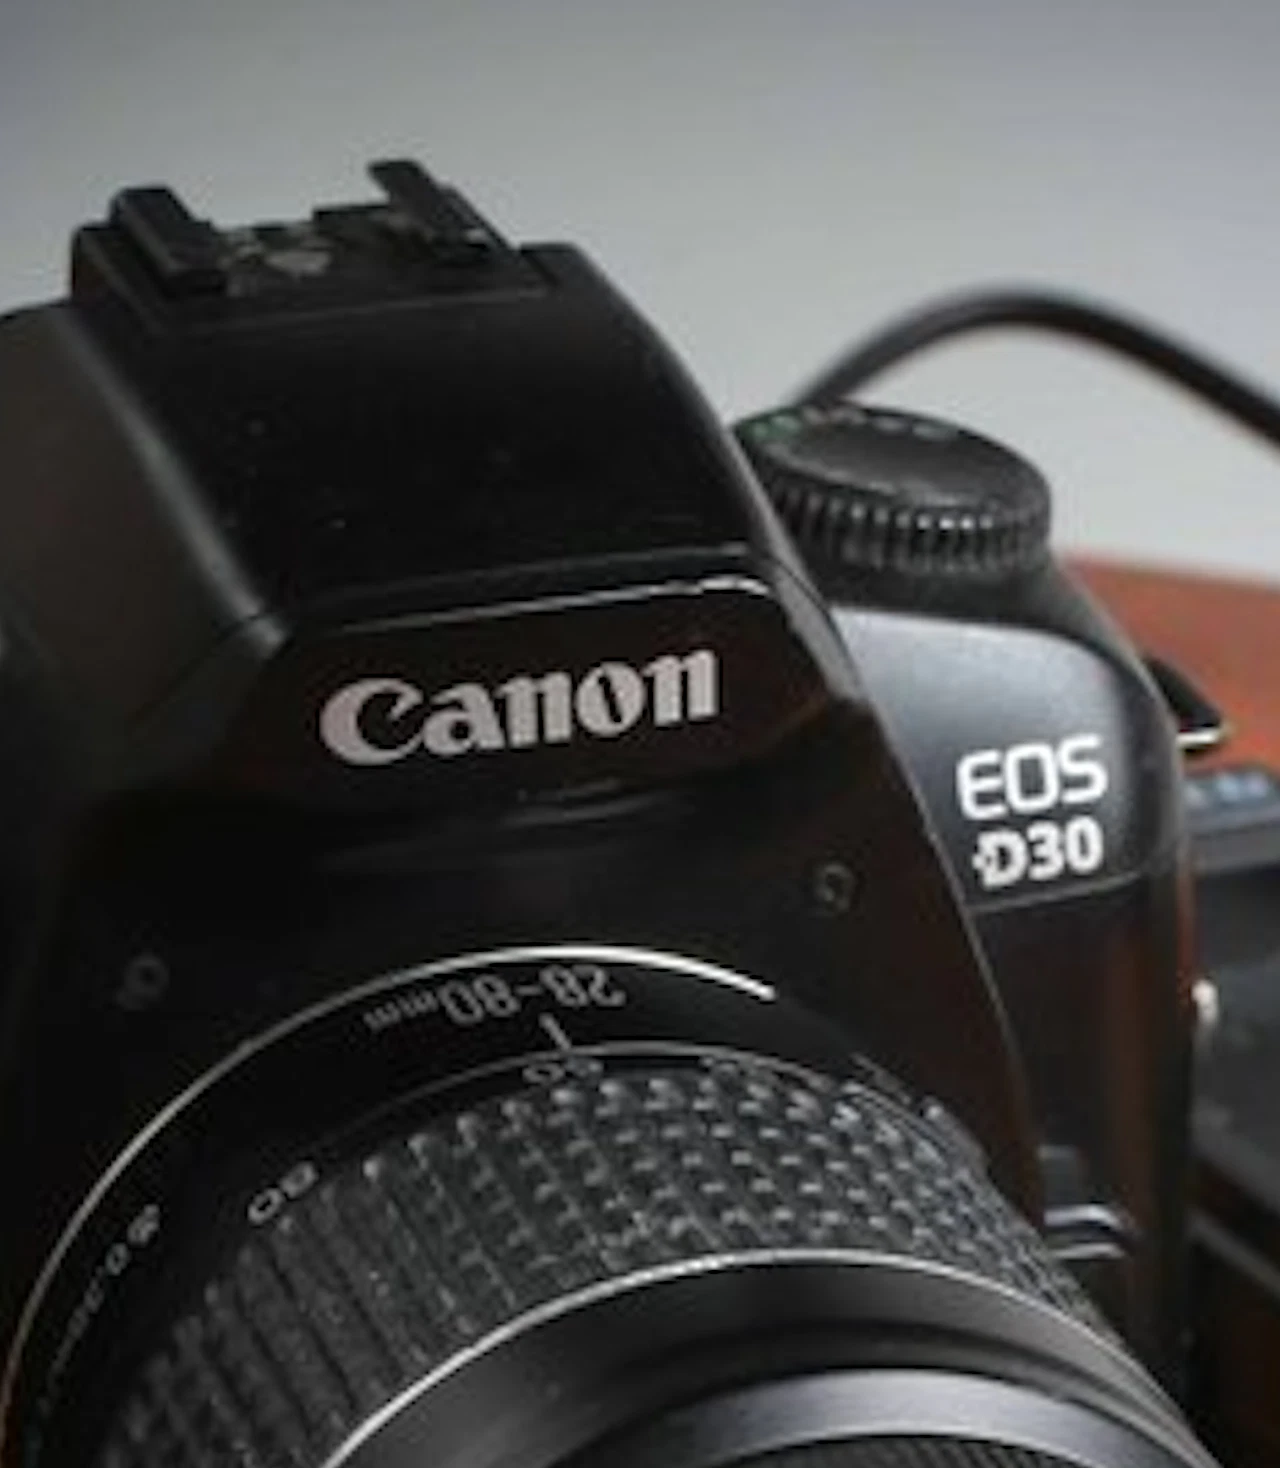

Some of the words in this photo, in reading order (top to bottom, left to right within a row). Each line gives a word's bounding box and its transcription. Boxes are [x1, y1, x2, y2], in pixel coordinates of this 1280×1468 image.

[319, 649, 719, 767] Canon
[957, 733, 1108, 820] EOS
[973, 814, 1104, 889] D30
[362, 964, 624, 1032] 28-80mm
